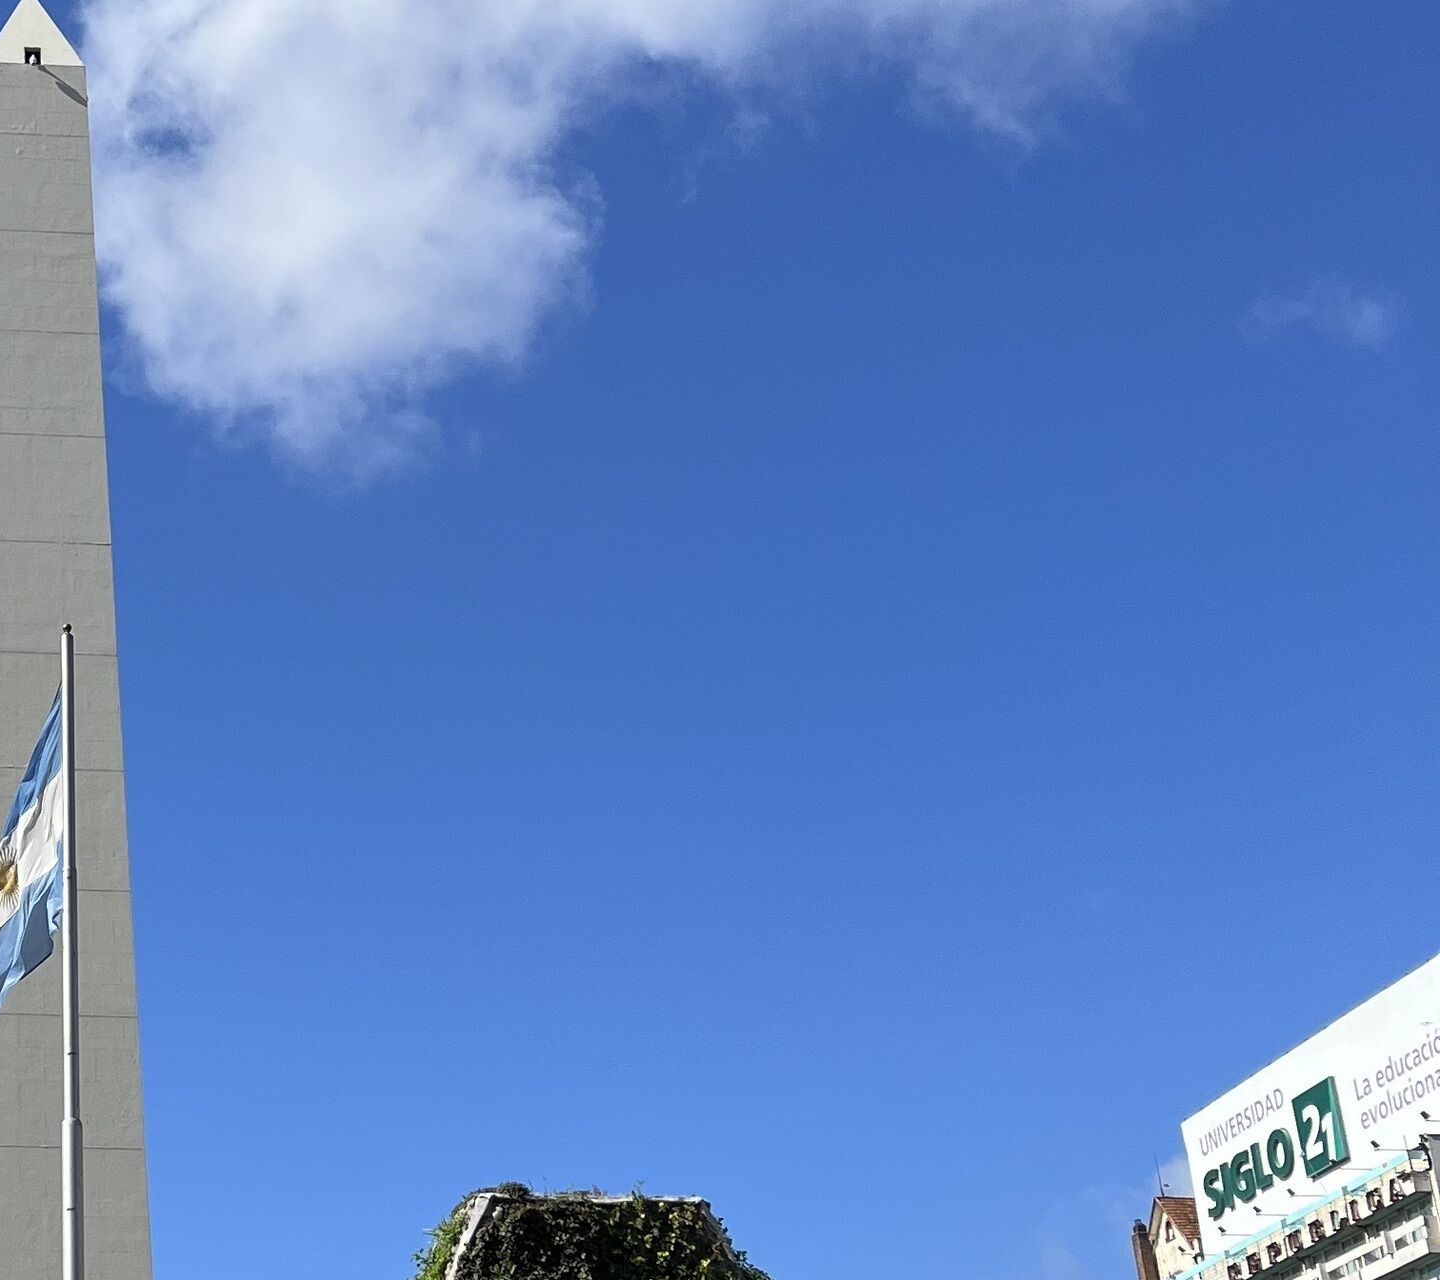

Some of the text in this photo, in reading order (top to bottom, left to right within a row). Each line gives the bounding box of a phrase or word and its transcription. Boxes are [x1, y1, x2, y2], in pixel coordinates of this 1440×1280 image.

[1198, 1087, 1285, 1157] UNIVERSIDAD
[1352, 1077, 1373, 1102] La
[1203, 1127, 1295, 1221] SIGLO
